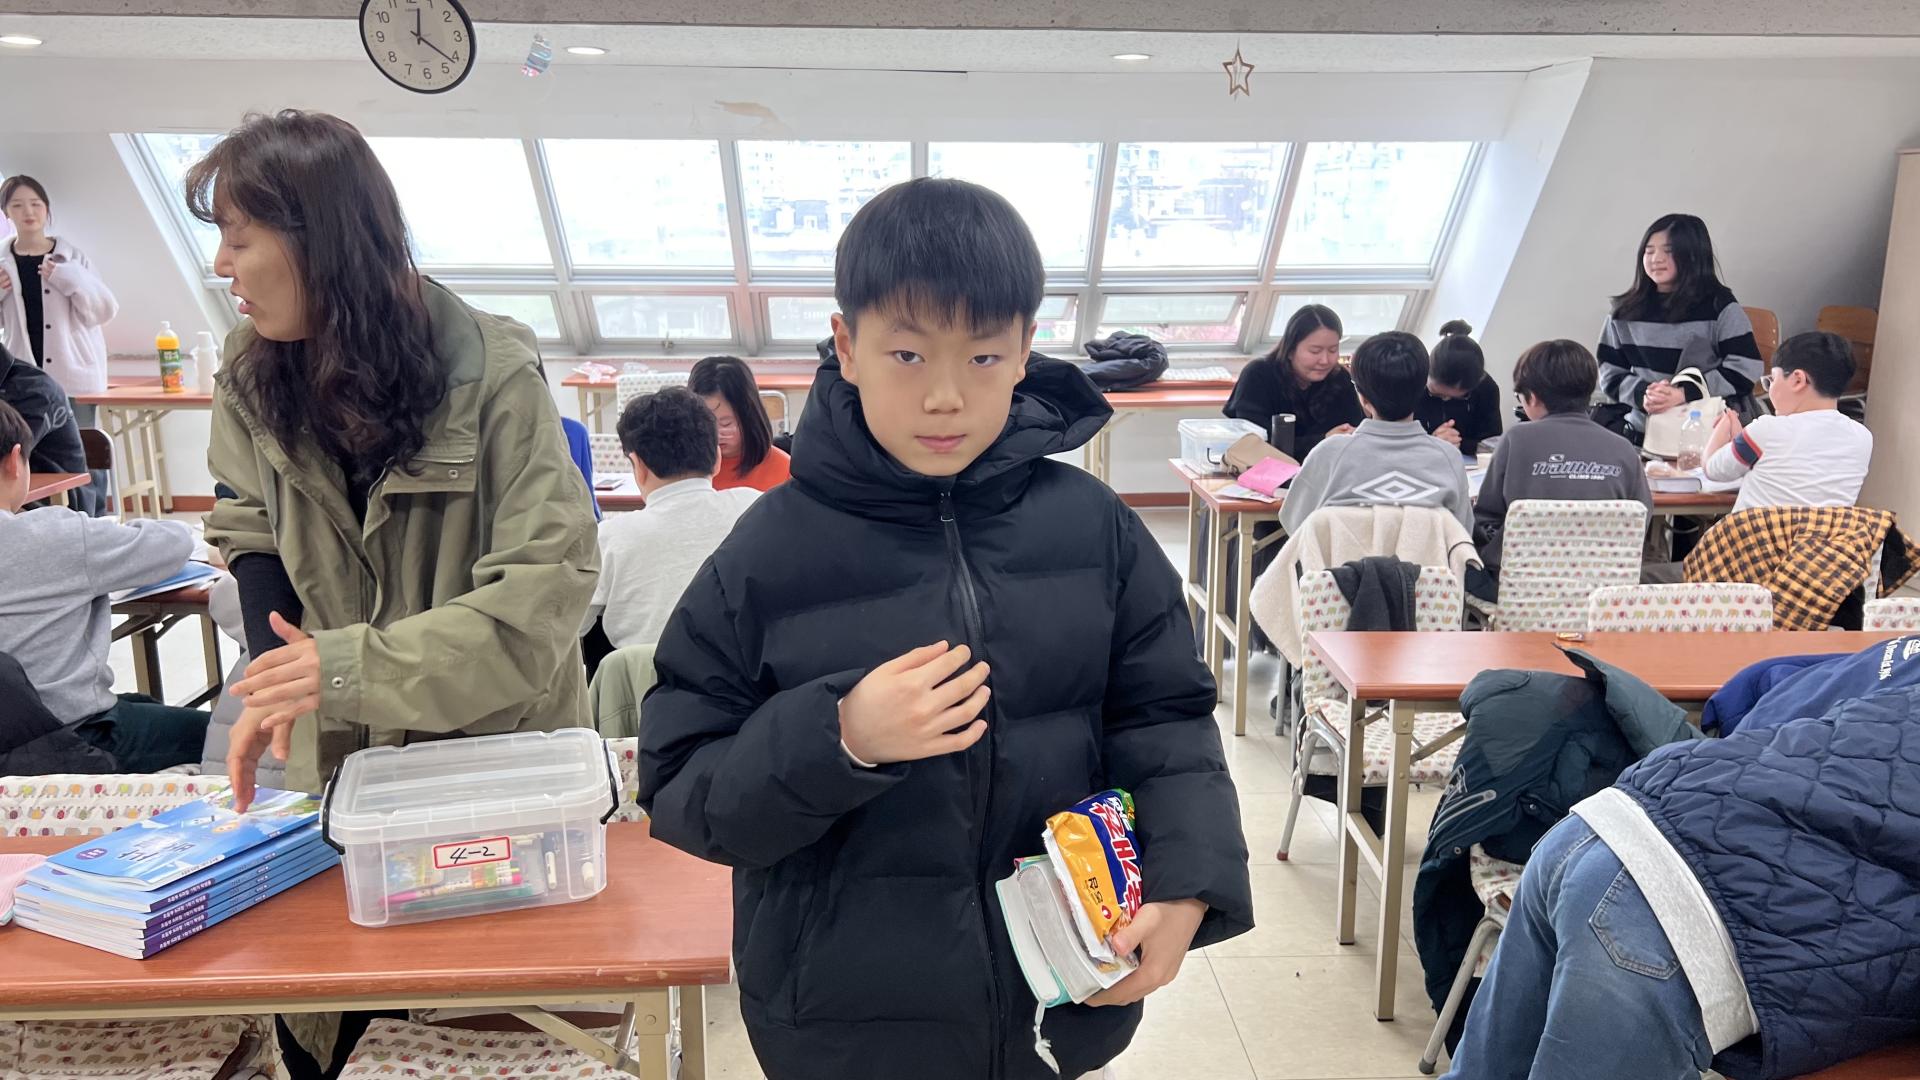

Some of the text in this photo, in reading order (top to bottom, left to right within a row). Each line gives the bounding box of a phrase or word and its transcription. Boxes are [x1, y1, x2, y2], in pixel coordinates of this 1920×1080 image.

[376, 11, 390, 24] 10
[442, 10, 453, 23] 2
[375, 30, 385, 43] 9
[453, 30, 463, 43] 3
[388, 51, 398, 63] 8
[451, 50, 460, 62] 4
[404, 63, 413, 76] 7
[423, 67, 432, 80] 6
[441, 62, 450, 74] 5
[449, 846, 496, 865] 4-2
